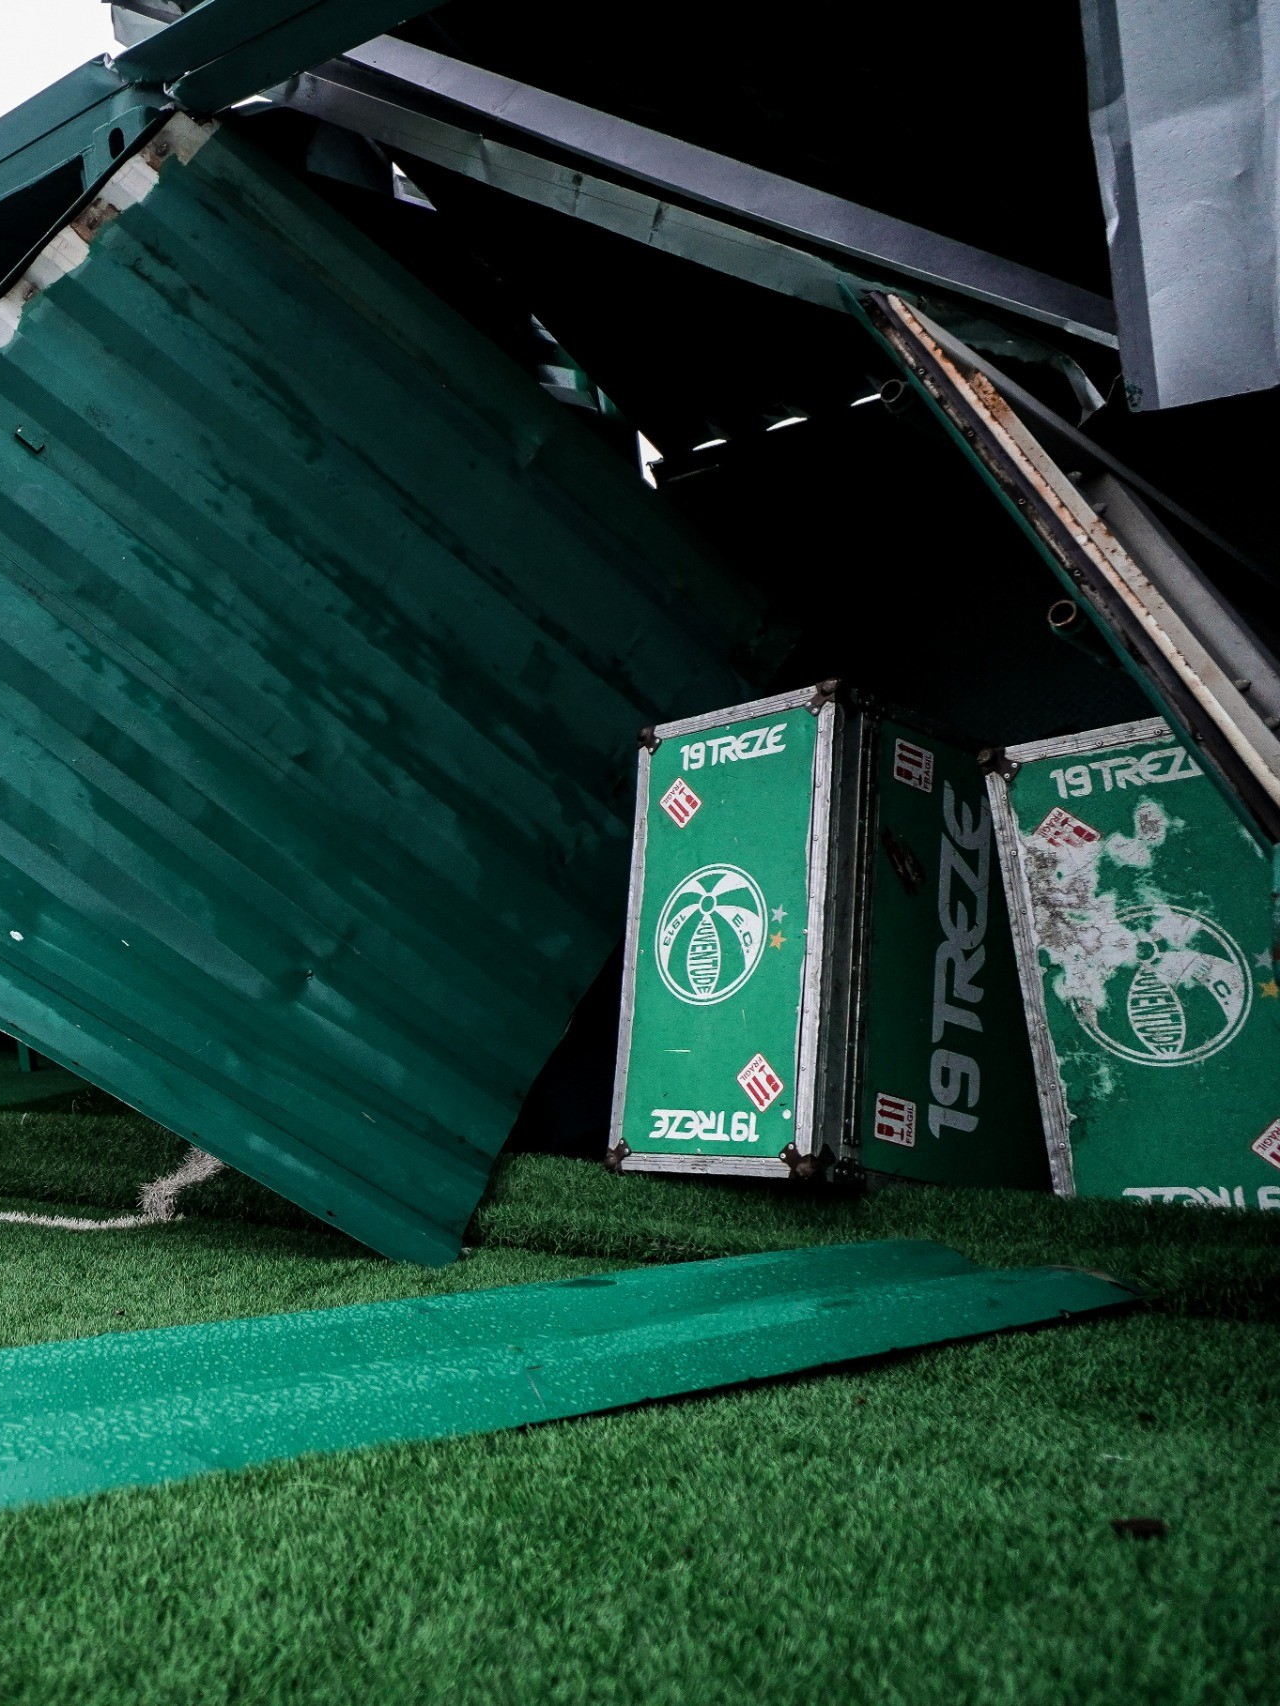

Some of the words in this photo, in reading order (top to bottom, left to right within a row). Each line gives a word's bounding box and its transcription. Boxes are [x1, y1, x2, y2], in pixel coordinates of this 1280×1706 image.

[706, 723, 787, 767] TREZE
[1088, 746, 1205, 792] TREZ
[932, 780, 992, 1043] TREZE
[688, 920, 718, 994] JUVENTUDE
[1130, 968, 1183, 1054] JUVENTUDE
[649, 1109, 730, 1141] TREZE
